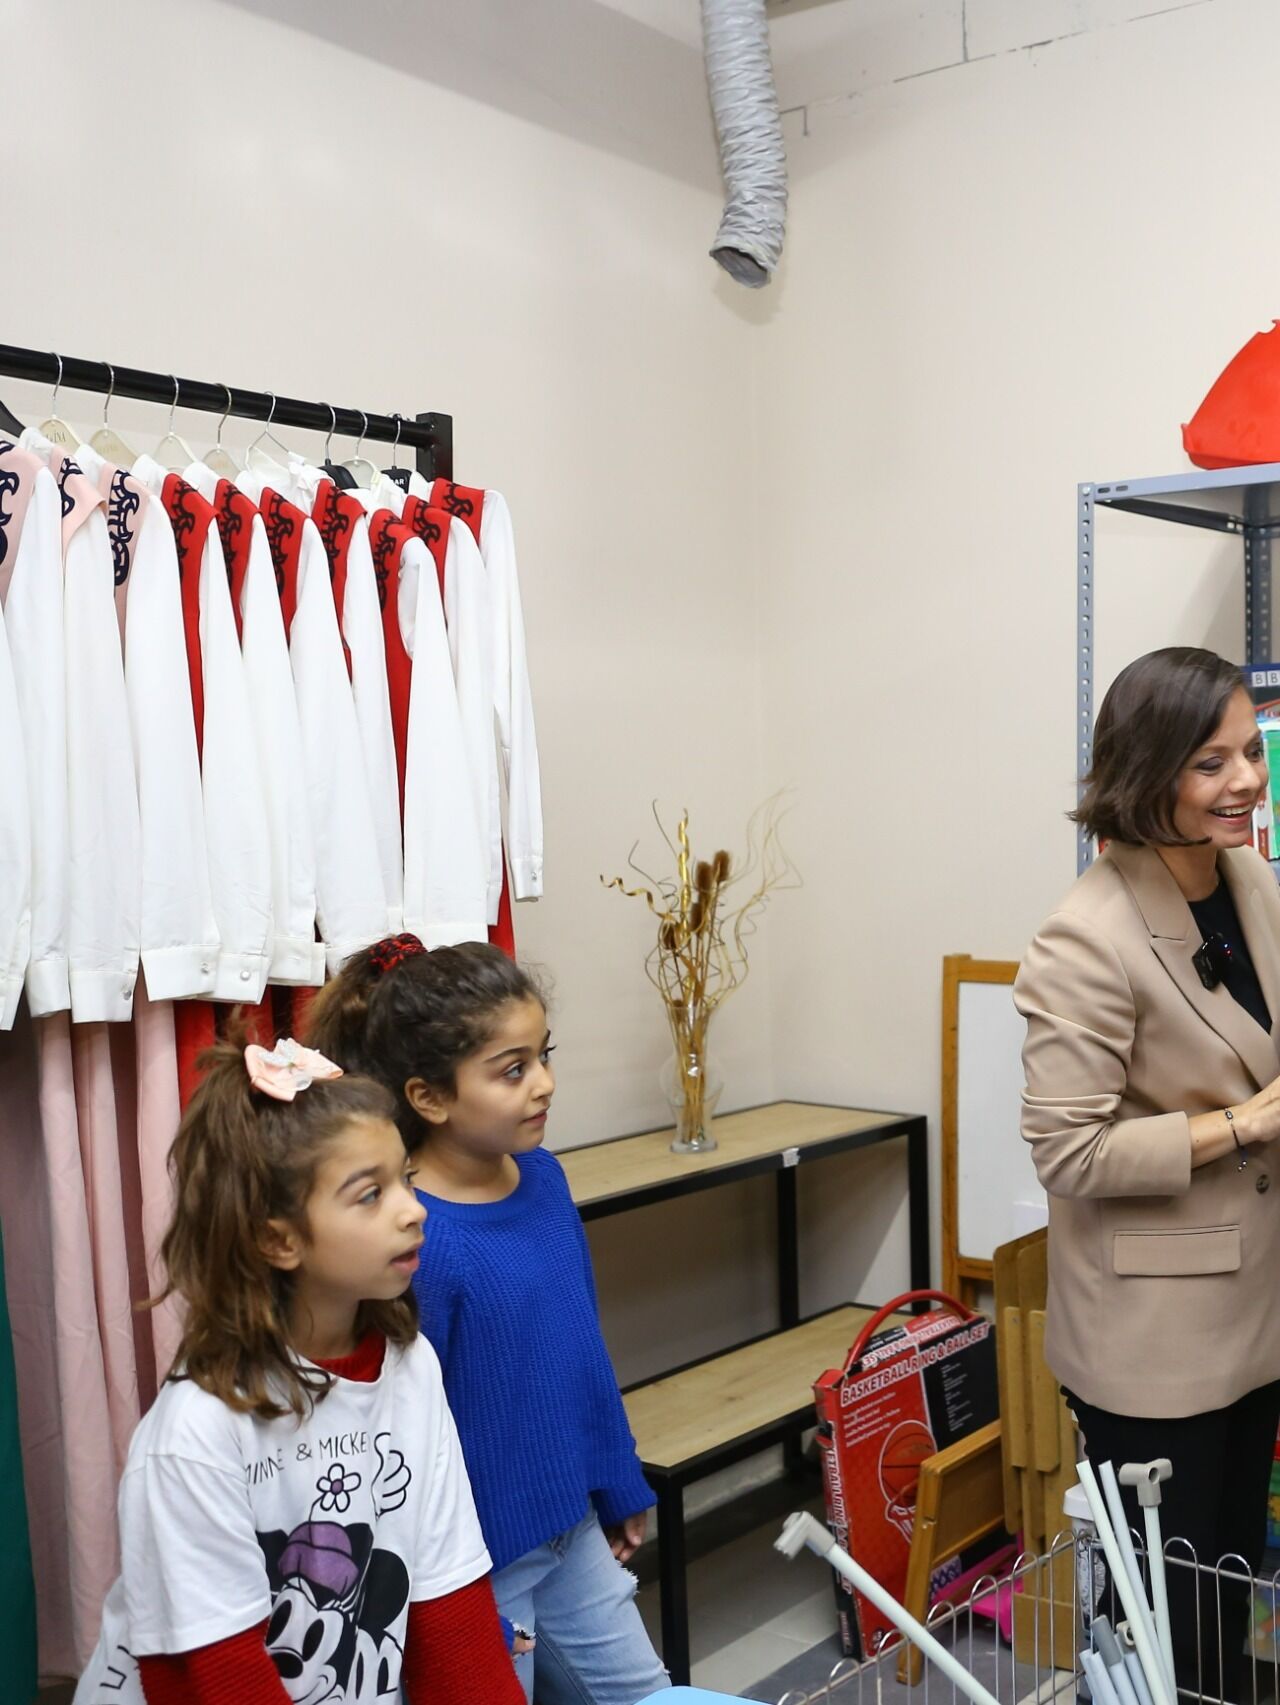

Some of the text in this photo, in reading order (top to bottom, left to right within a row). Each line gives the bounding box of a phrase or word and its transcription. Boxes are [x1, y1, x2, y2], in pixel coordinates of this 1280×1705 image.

[841, 1358, 911, 1404] BASKETBALL
[909, 1348, 937, 1371] RING
[936, 1344, 945, 1358] &
[946, 1334, 970, 1355] BALL
[970, 1322, 990, 1342] SET
[296, 1443, 312, 1461] &
[319, 1431, 367, 1459] MICKE
